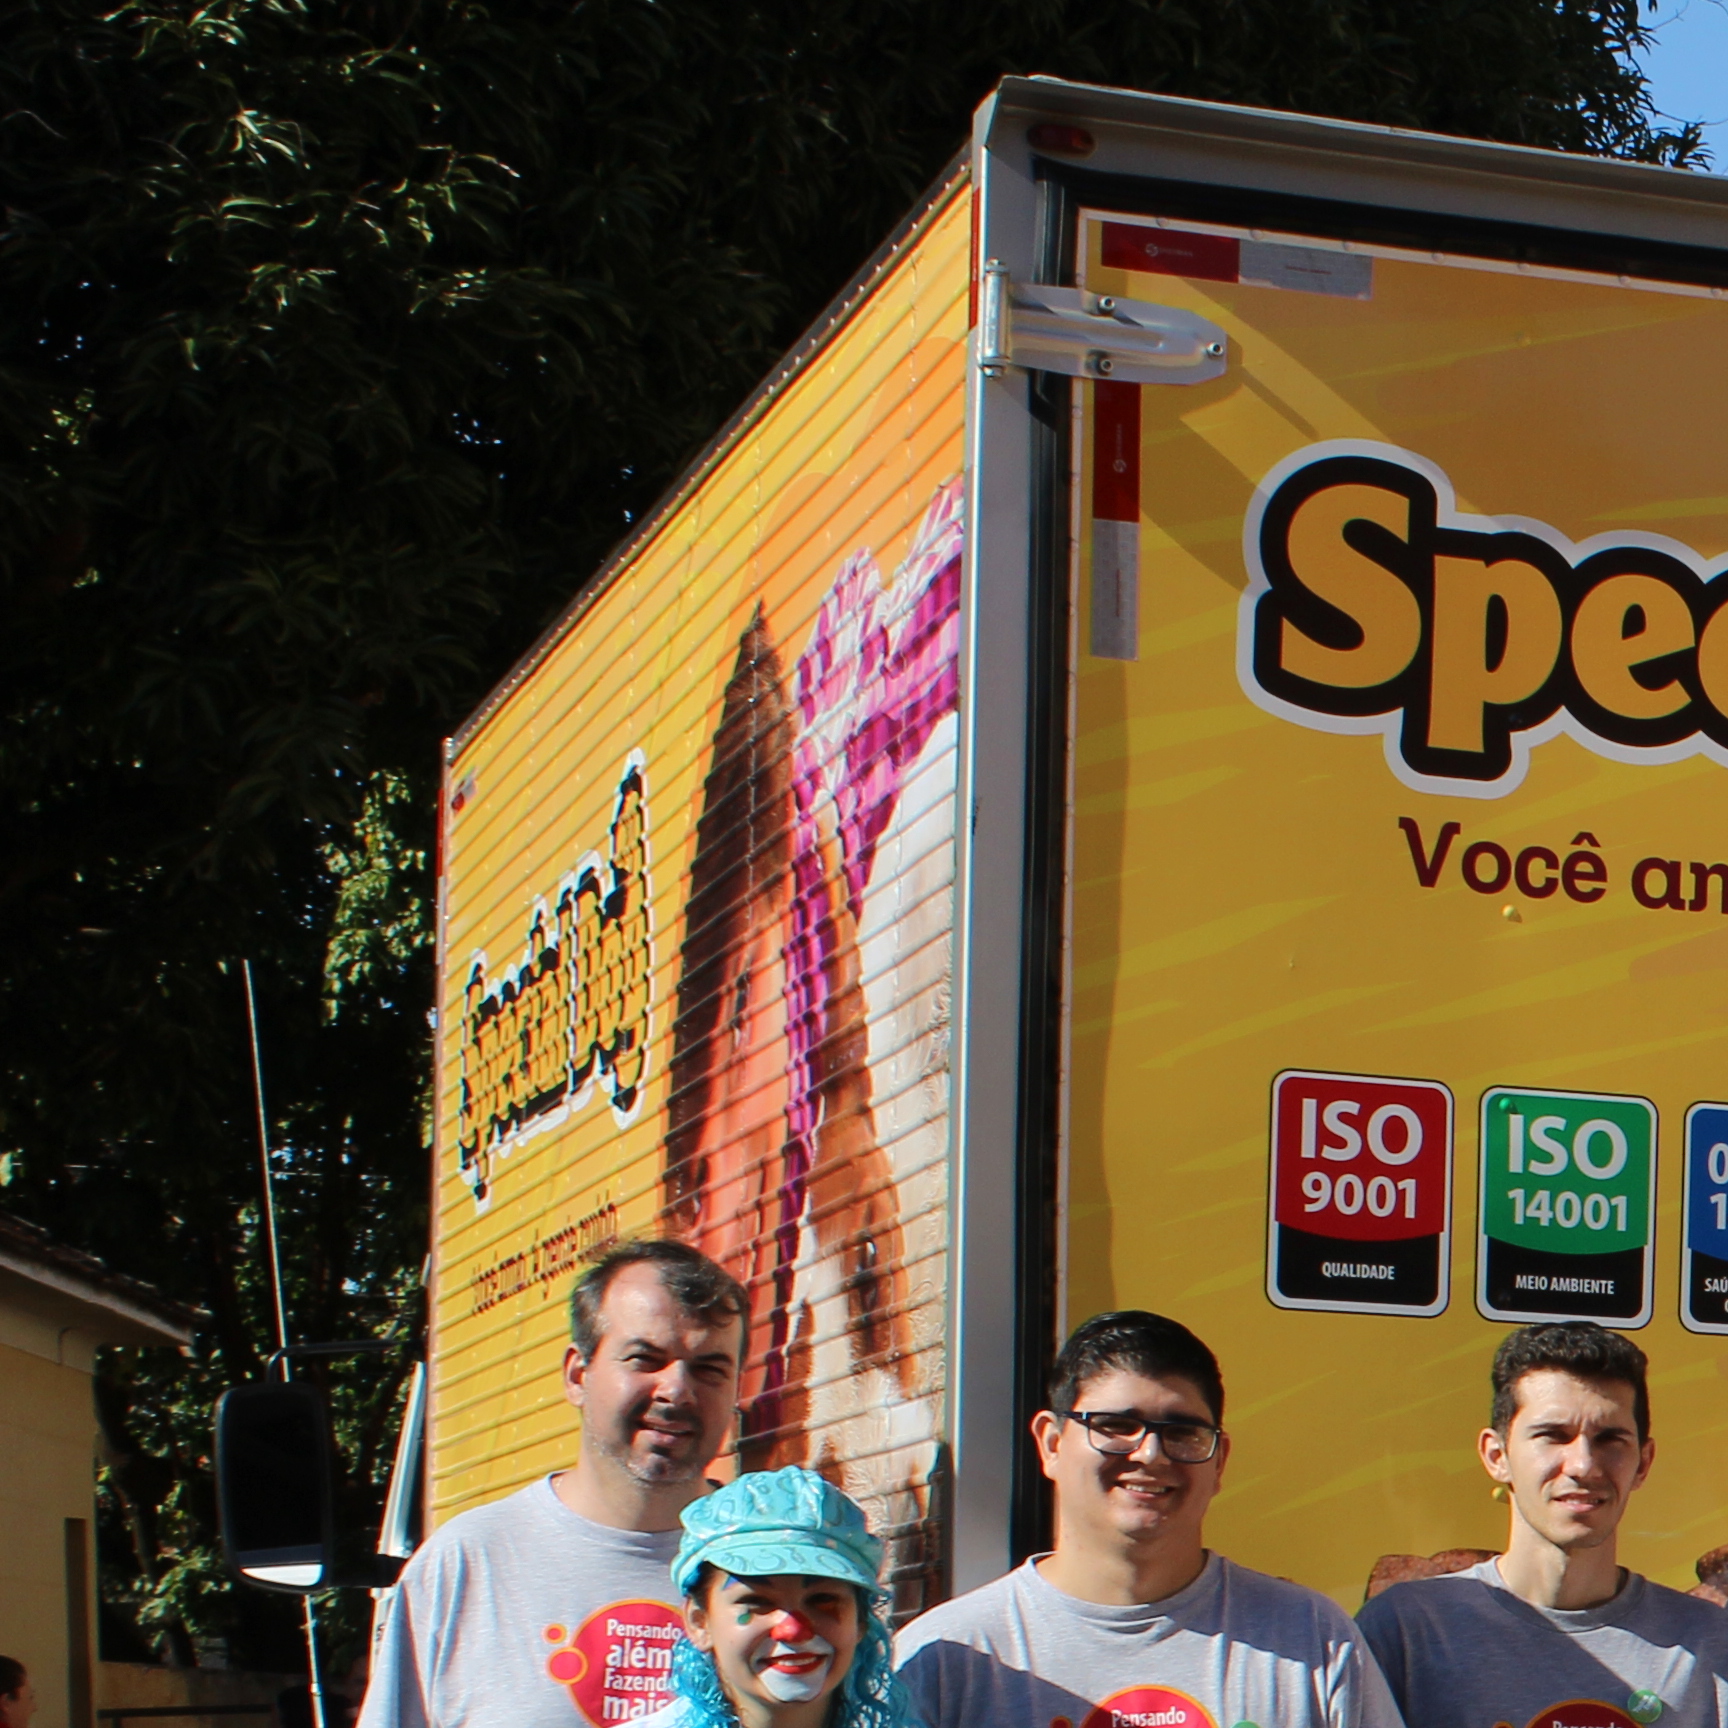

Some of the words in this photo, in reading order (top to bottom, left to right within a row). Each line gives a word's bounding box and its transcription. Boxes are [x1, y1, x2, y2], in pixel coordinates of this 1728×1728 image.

[1398, 816, 1608, 903] Você
[1300, 1097, 1424, 1166] ISO
[1507, 1112, 1629, 1180] ISO
[1301, 1170, 1418, 1220] 9001
[1506, 1187, 1628, 1232] 14001
[1320, 1260, 1396, 1281] QUALIDADE
[1515, 1273, 1549, 1292] MEIO
[1550, 1276, 1615, 1295] AMBIENTE
[1110, 1705, 1187, 1728] Pensando
